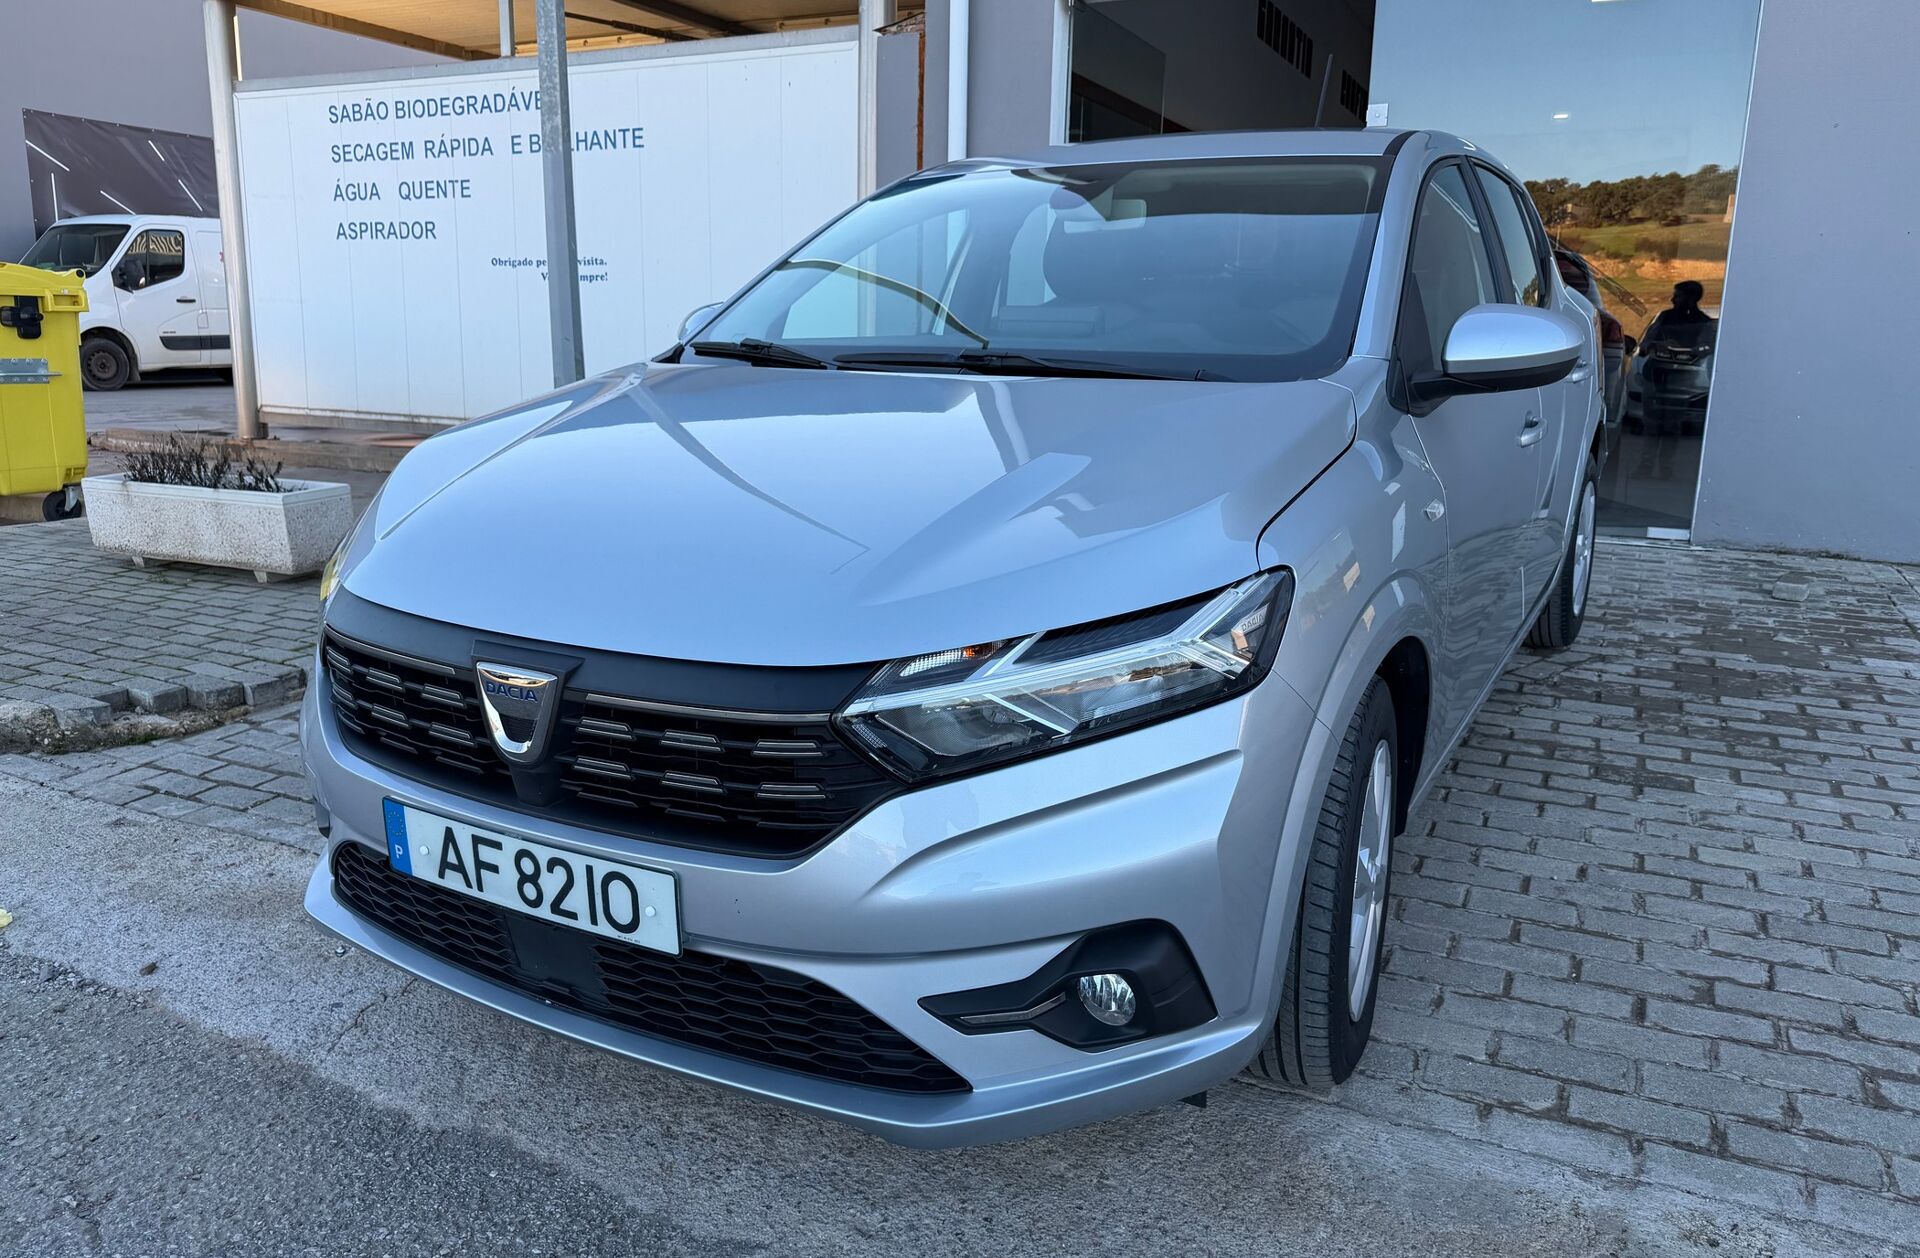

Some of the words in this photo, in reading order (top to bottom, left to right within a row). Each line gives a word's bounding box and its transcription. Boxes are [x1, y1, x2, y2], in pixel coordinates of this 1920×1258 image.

[329, 98, 389, 123] SABÃO
[394, 86, 542, 119] BIODEGRADÁVE
[331, 141, 414, 163] SECAGEM
[424, 134, 493, 159] RÁPIDA
[510, 135, 522, 154] E
[529, 127, 645, 154] BHANTE
[333, 179, 381, 202] ÁGUA
[398, 179, 471, 201] QUENTE
[336, 221, 437, 240] ASPIRADOR
[491, 257, 533, 268] Obrigado
[486, 681, 538, 702] DACIA
[394, 844, 403, 859] P
